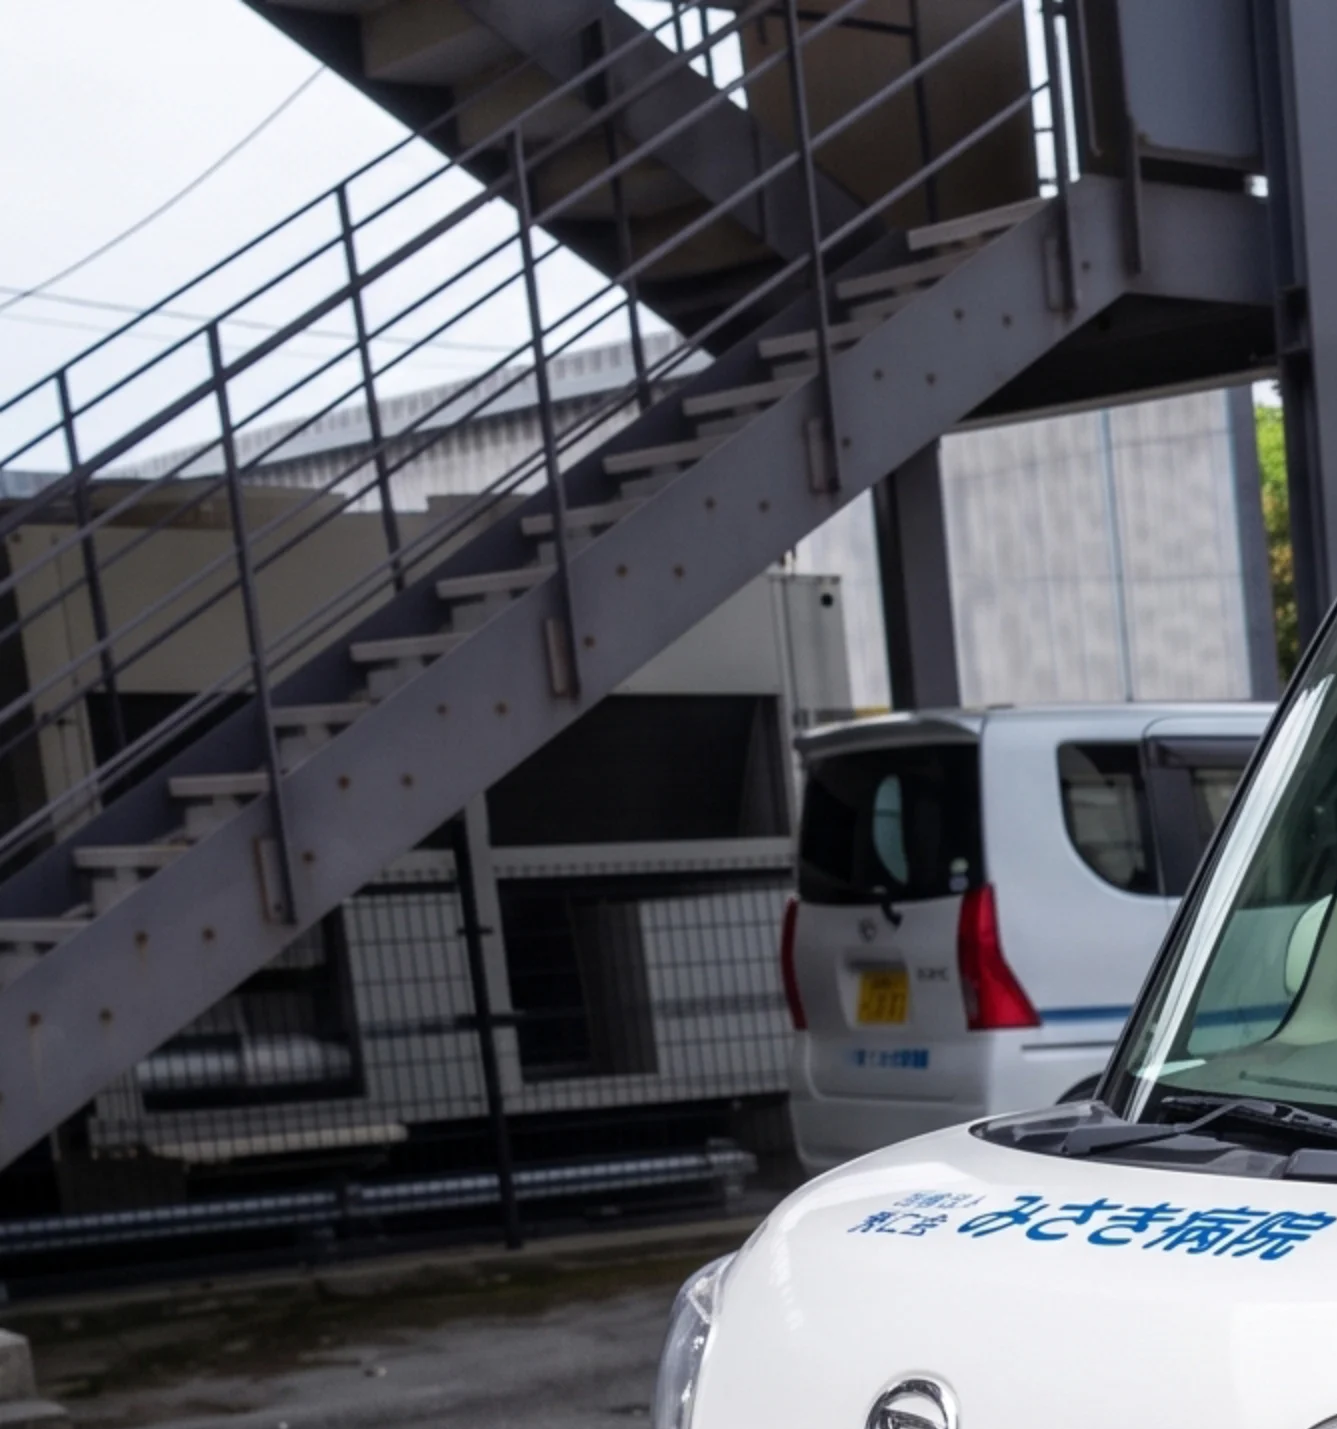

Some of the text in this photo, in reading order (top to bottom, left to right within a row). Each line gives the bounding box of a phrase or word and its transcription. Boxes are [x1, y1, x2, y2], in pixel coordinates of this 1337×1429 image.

[957, 1195, 1337, 1260] みさき病院
